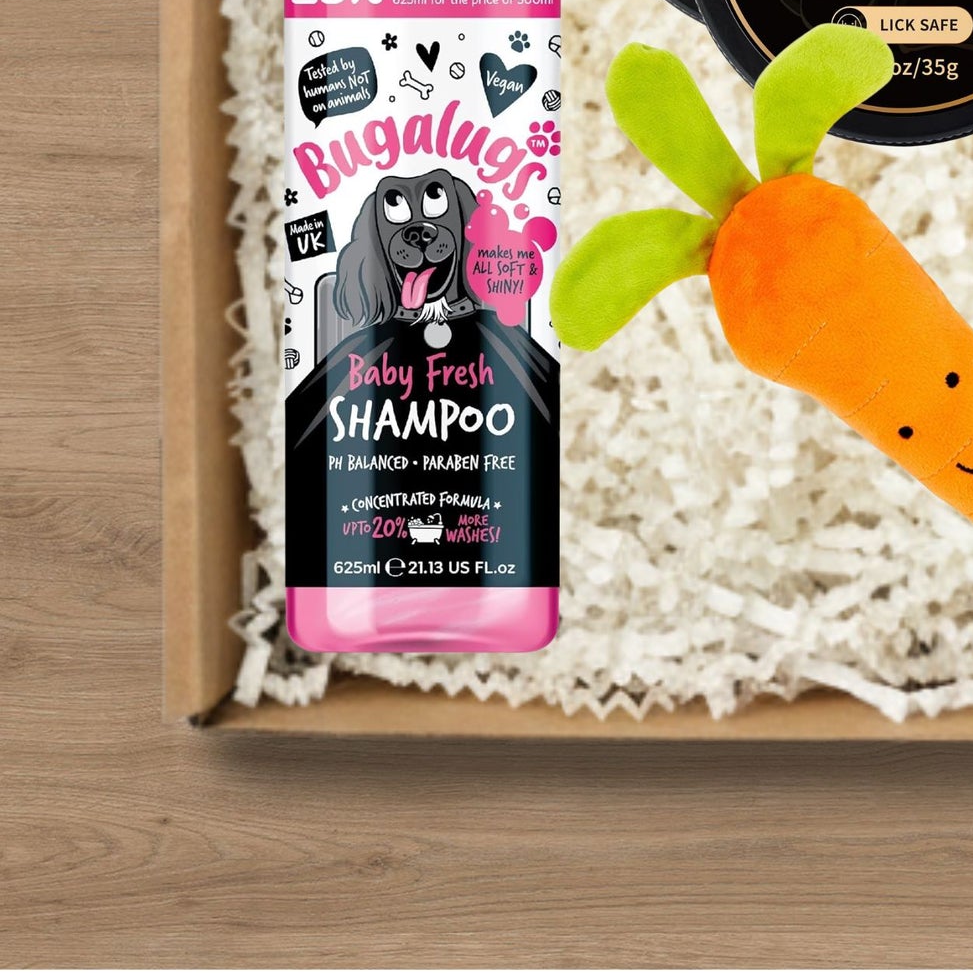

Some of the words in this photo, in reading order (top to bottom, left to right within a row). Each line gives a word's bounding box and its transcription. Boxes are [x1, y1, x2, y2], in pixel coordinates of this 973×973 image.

[880, 18, 915, 32] LICK
[920, 18, 958, 32] SAFE
[303, 60, 340, 81] Tested
[340, 57, 356, 74] by
[303, 78, 347, 99] humans
[485, 70, 524, 96] Vegan
[312, 102, 327, 113] on
[327, 86, 371, 108] animals
[293, 100, 547, 201] Bugalugs
[290, 219, 314, 236] Made
[313, 218, 324, 229] in
[297, 231, 325, 255] UK
[477, 245, 513, 260] makes
[517, 250, 535, 259] me
[472, 261, 493, 275] ALL
[496, 260, 526, 277] SOFT
[528, 263, 538, 276] &
[486, 278, 524, 295] SHINY!
[348, 352, 413, 400] Baby
[426, 352, 494, 392] Fresh
[328, 395, 515, 442] SHAMPOO
[328, 454, 342, 471] PH
[347, 454, 409, 471] BALANCED
[423, 454, 479, 471] PARABEN
[484, 454, 515, 471] FREE
[351, 491, 436, 512] CONCENTRATED
[439, 491, 490, 510] FORMULA
[372, 516, 408, 539] 20%
[457, 514, 489, 526] MORE
[445, 526, 501, 543] WASHES!
[333, 561, 381, 574] 625ml
[408, 561, 444, 574] 21.13
[449, 561, 470, 574] US
[475, 561, 516, 574] FL.oz
